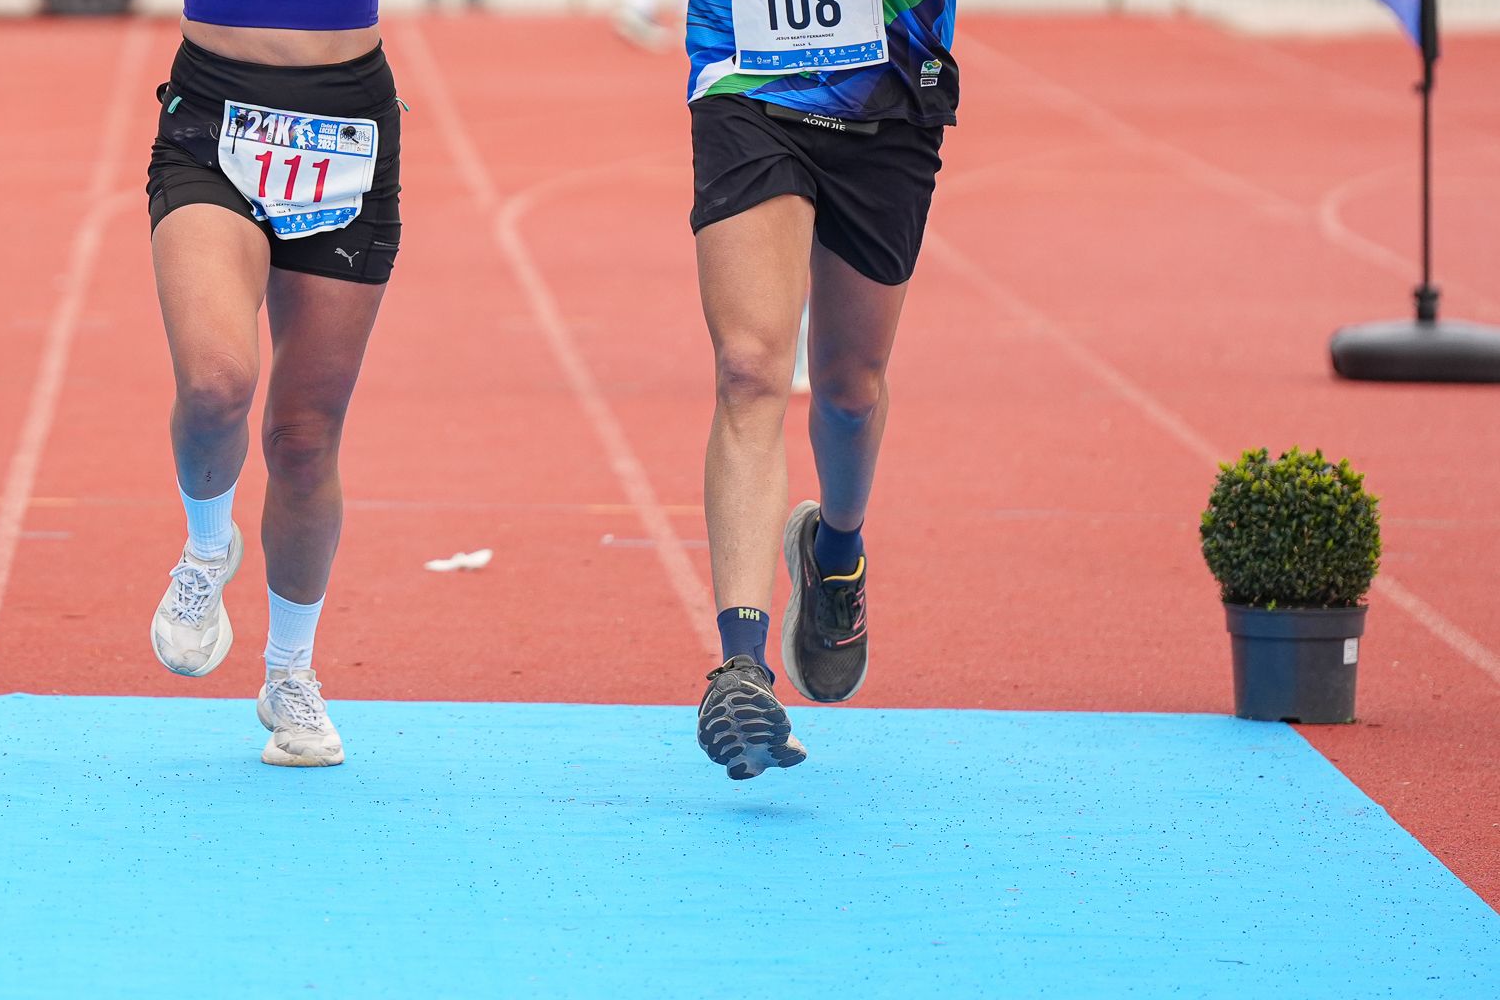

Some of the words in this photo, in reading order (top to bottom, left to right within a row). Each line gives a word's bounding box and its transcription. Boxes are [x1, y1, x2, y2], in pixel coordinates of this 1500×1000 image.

[244, 110, 294, 146] 21K
[317, 139, 336, 150] 2026
[255, 150, 331, 203] 111
